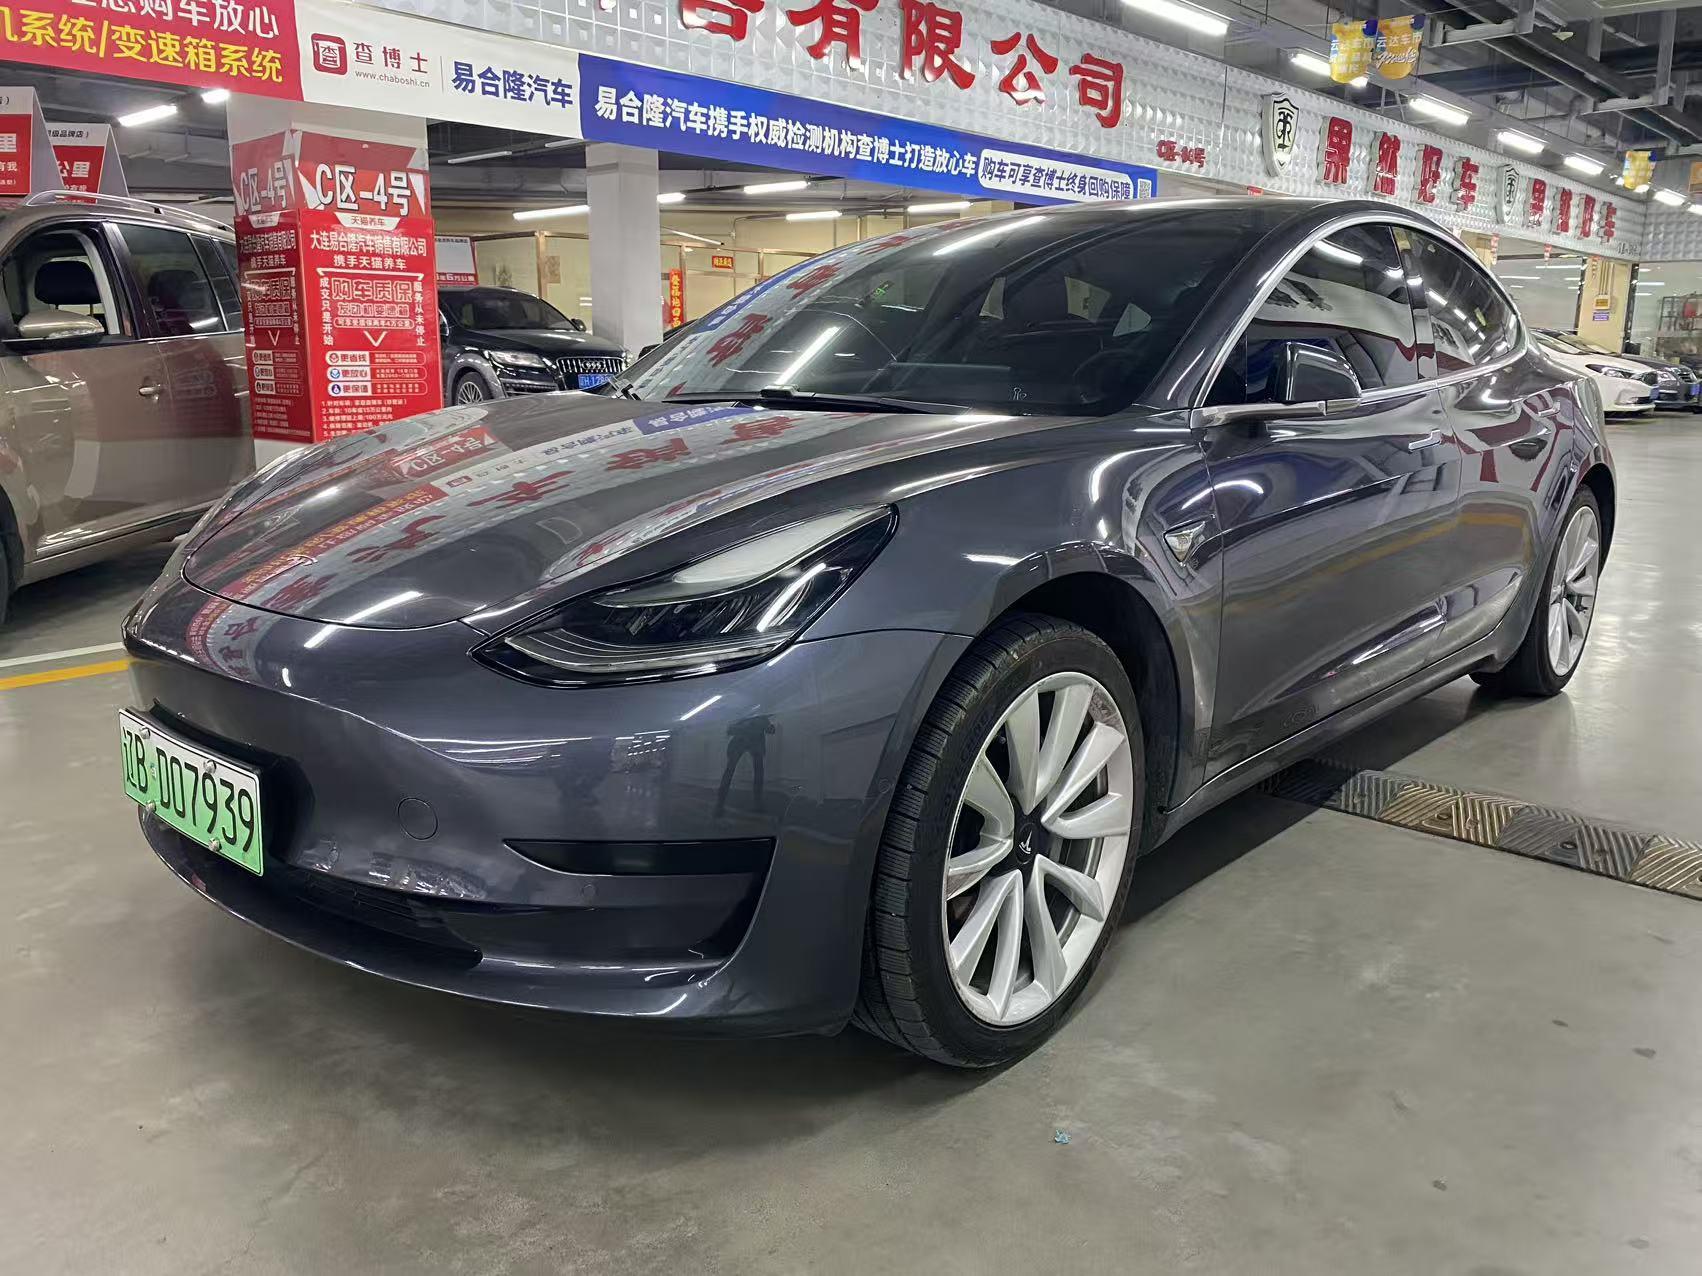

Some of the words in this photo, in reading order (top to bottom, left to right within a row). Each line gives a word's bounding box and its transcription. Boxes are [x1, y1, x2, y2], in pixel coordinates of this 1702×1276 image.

[71, 0, 279, 39] 购车放心
[353, 41, 428, 74] 查博士
[354, 69, 430, 88] www.chaboshi.cn
[451, 60, 574, 109] 易合隆汽车
[594, 85, 978, 179] 易合隆汽车携手权威检测机构查博士打造放心车
[240, 161, 287, 213] C区-4号
[316, 163, 411, 216] C区-4号
[981, 157, 1132, 200] 购车可享查博士终身回购保障
[351, 216, 386, 227] 天猫养车
[310, 229, 427, 257] 大连易合隆汽车销售有限公司
[333, 255, 407, 270] 携手天猫养车
[331, 277, 413, 303] 购车质保
[320, 277, 334, 346] 成交只是开始
[337, 302, 410, 318] 发动机变速箱
[413, 281, 426, 346] 服务从未停止
